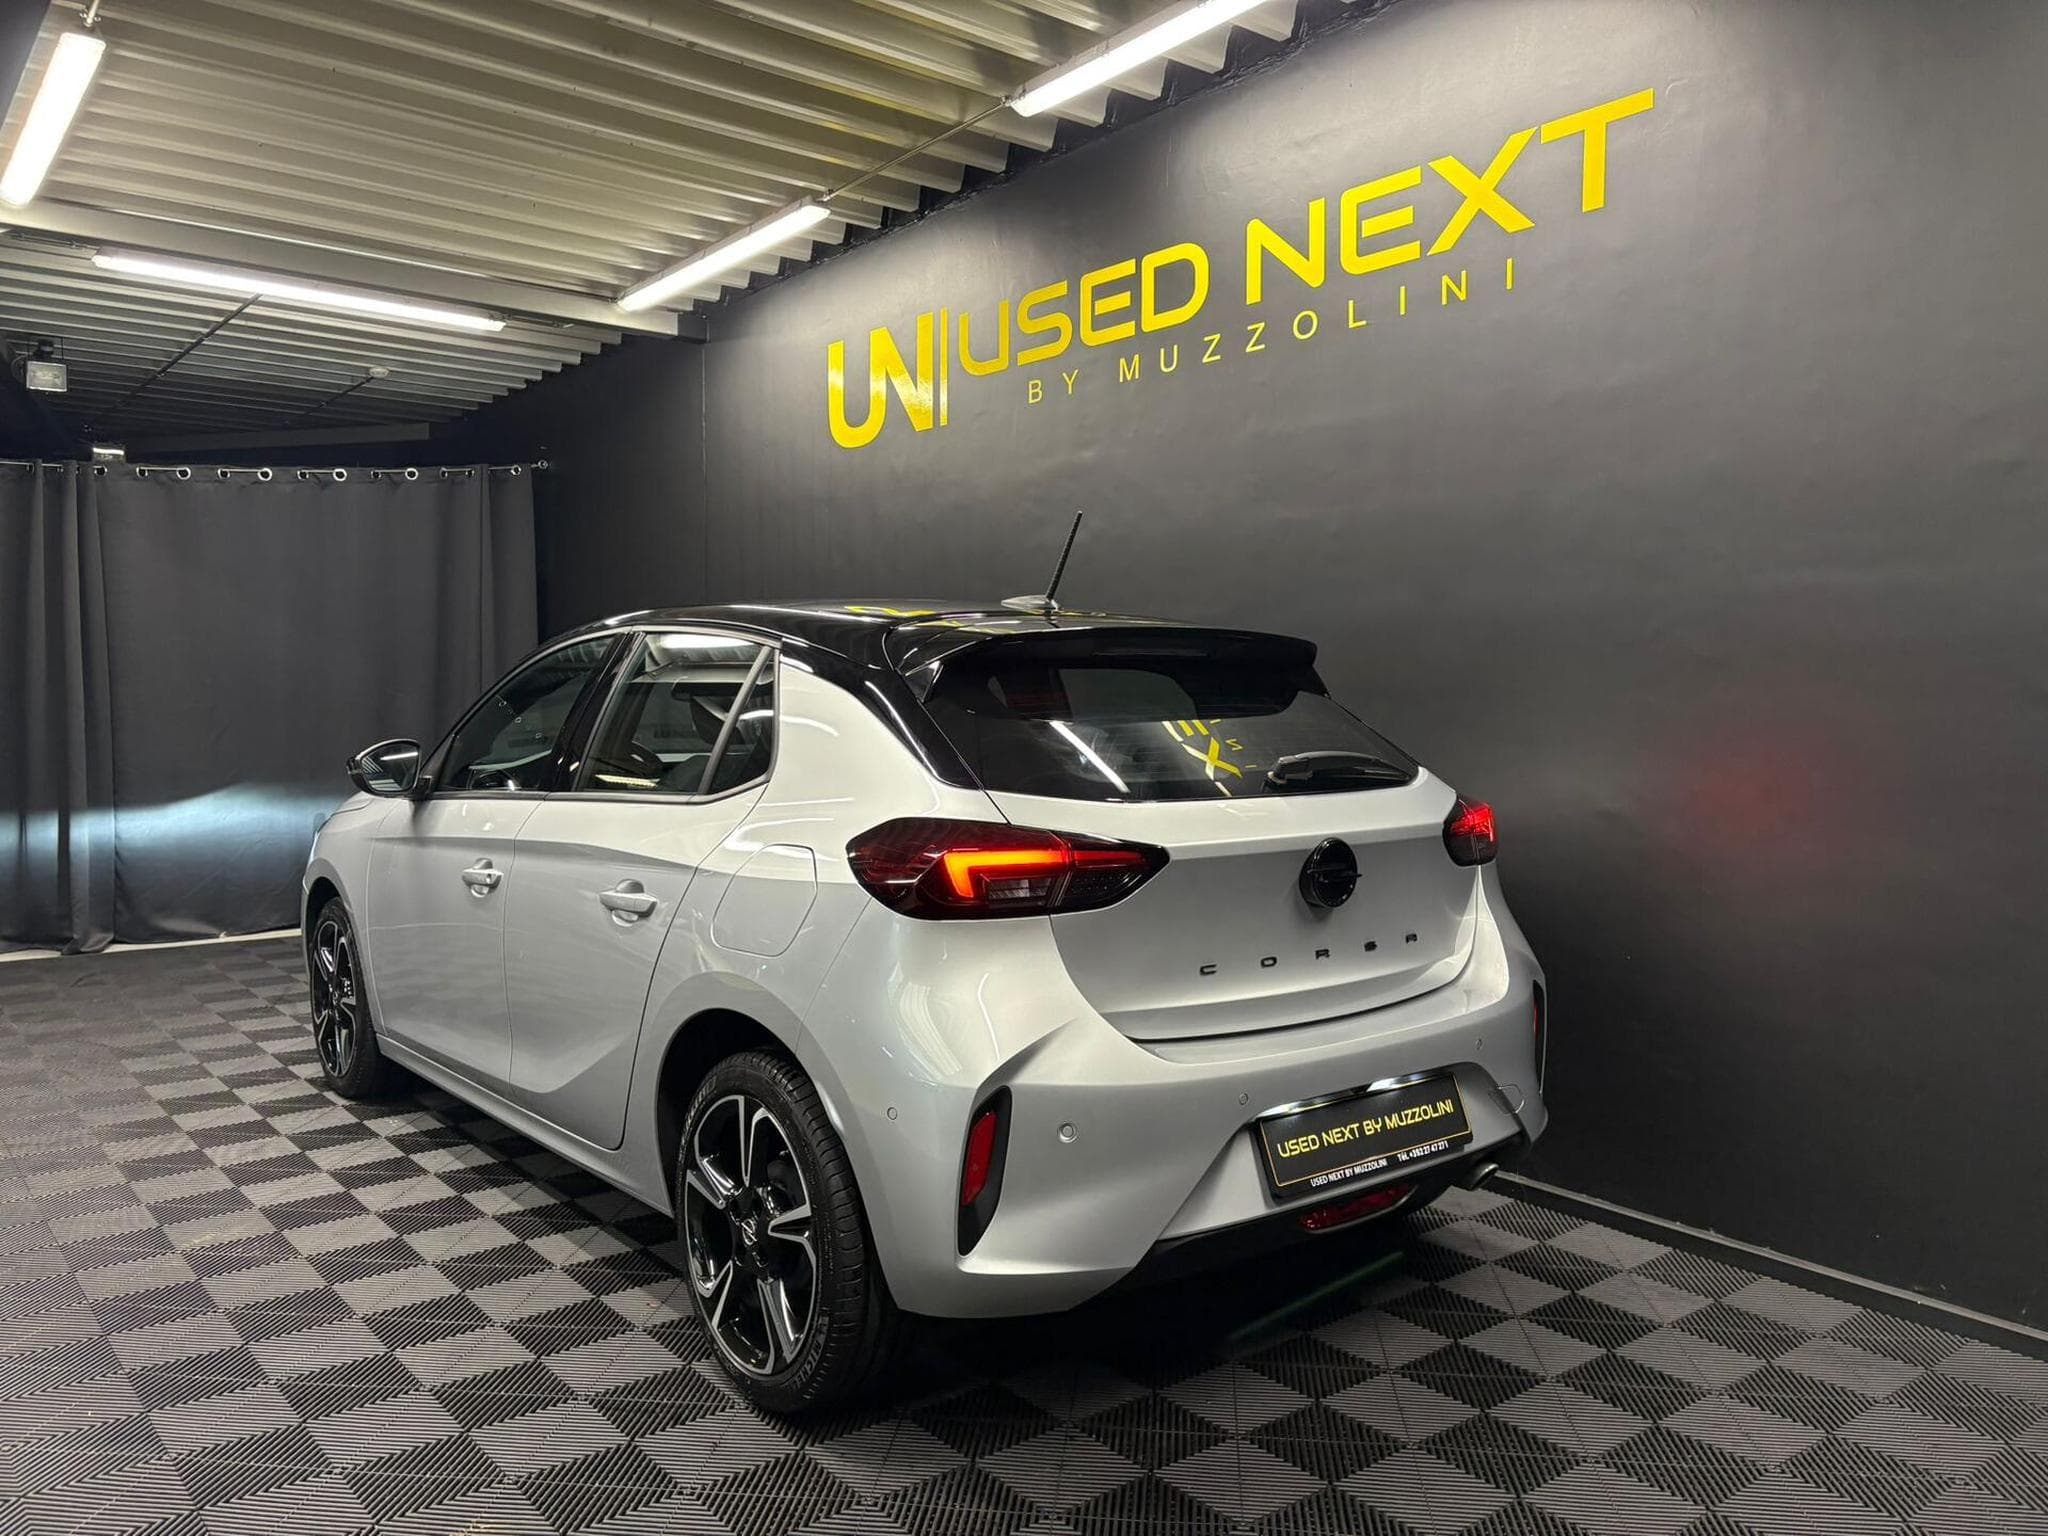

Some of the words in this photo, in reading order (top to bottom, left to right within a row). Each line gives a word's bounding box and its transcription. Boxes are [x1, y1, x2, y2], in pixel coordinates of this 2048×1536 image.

[957, 241, 1212, 379] USED
[1244, 87, 1657, 307] NEXT
[1027, 369, 1080, 405] BY
[1118, 258, 1517, 384] MUZZOLINI
[1199, 932, 1419, 977] CORSA
[1277, 1134, 1321, 1158] USED
[1322, 1123, 1360, 1147] NEXT
[1364, 1117, 1383, 1137] BY
[1385, 1099, 1454, 1130] MUZZOLINI
[1310, 1175, 1328, 1187] USED
[1328, 1170, 1346, 1184] NEXT
[1355, 1158, 1388, 1175] MUZZOLINI
